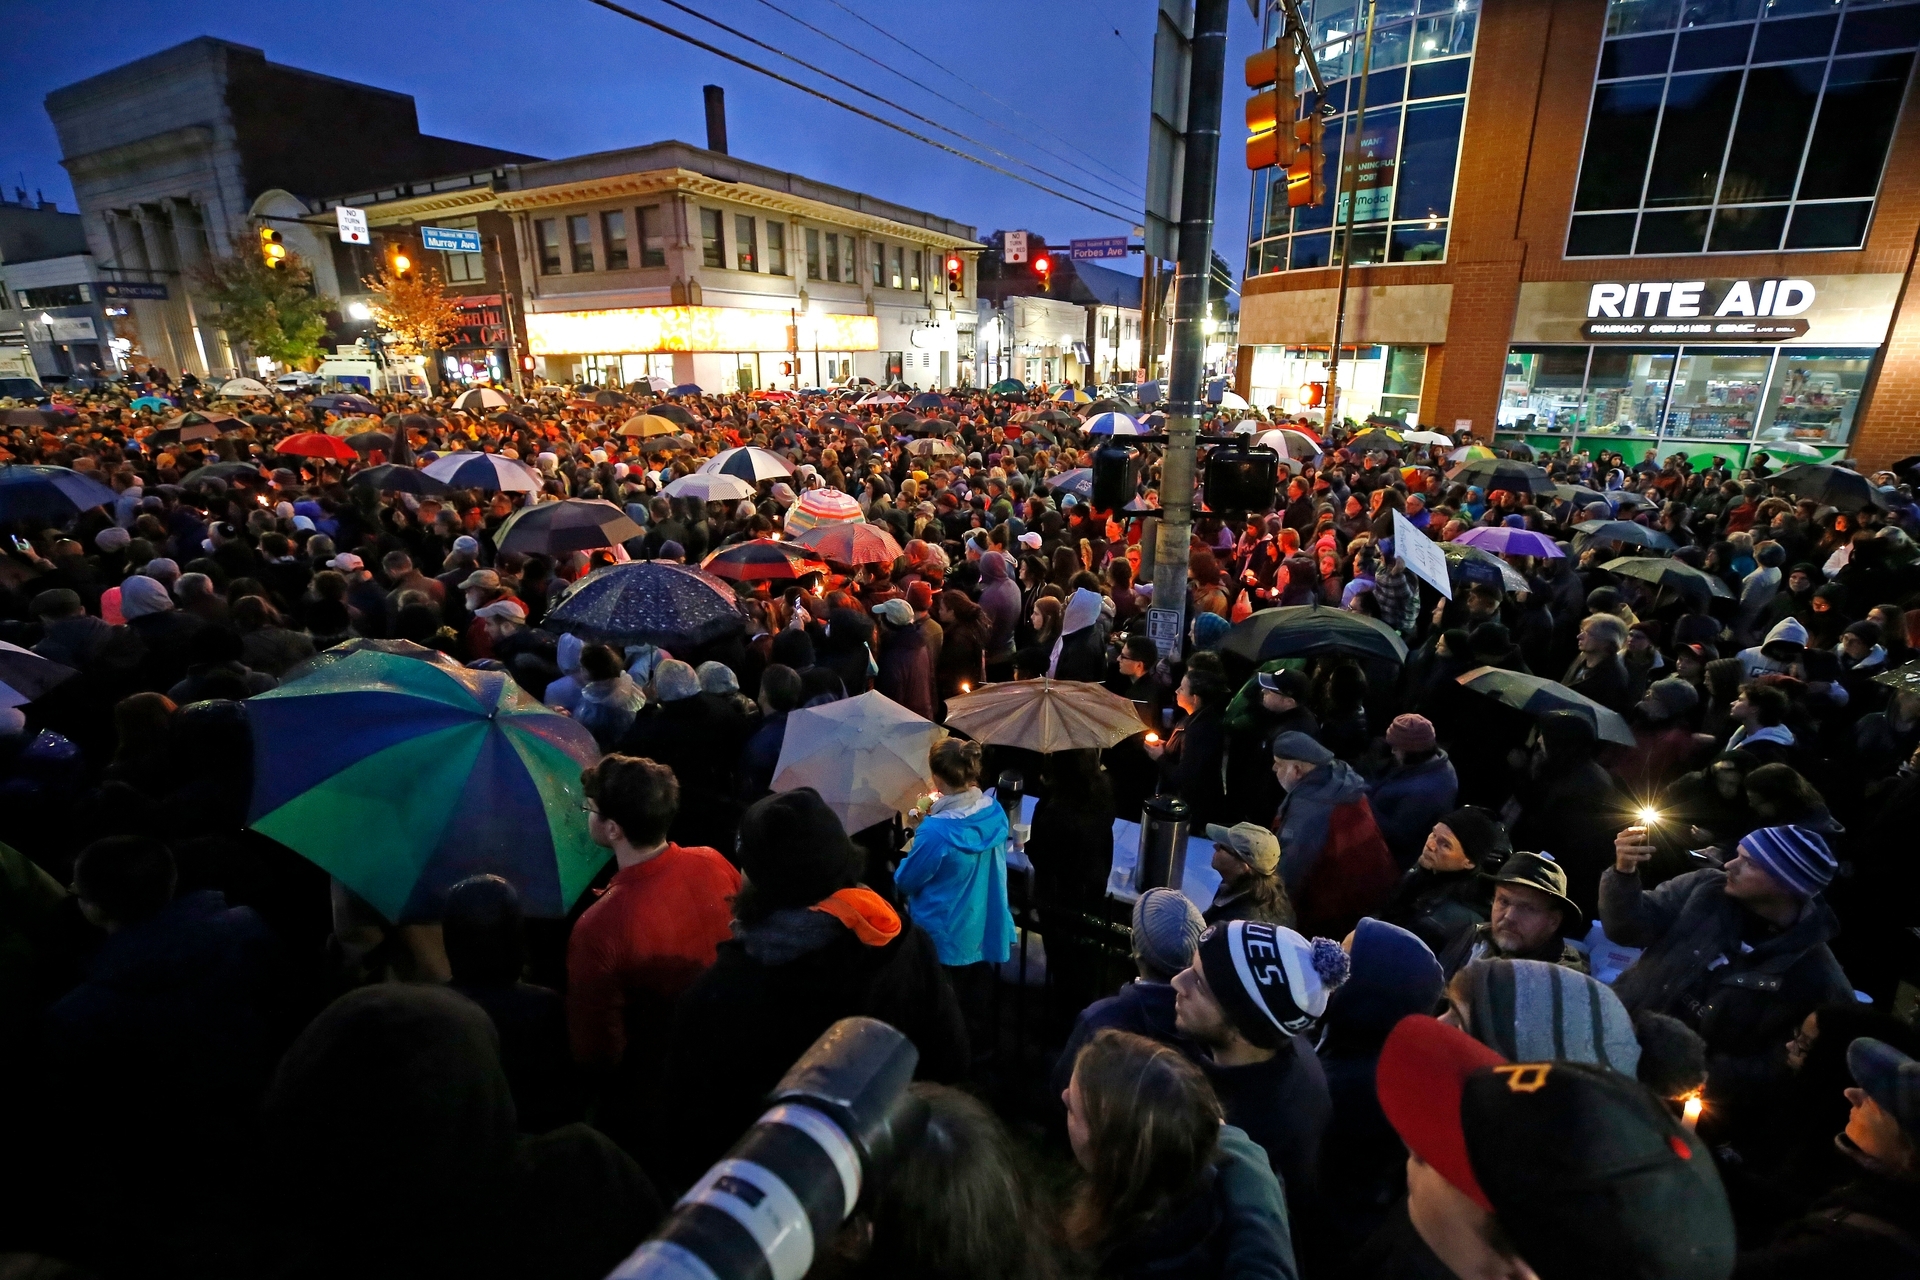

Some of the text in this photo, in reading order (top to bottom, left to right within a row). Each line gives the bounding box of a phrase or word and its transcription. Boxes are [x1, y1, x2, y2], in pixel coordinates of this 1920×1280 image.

[1361, 137, 1383, 147] WANT
[1367, 150, 1374, 158] A
[1345, 159, 1395, 172] MANINGFUL
[346, 209, 357, 217] NO
[428, 237, 476, 250] Murray Ave
[1074, 247, 1123, 258] Forbes Ave
[119, 286, 139, 295] PNC
[1587, 279, 1816, 318] RITE AID
[1590, 325, 1645, 333] PHARMACY
[1649, 324, 1677, 333] OPEN
[1676, 325, 1690, 333] 24
[1690, 324, 1711, 333] HRS
[1715, 324, 1756, 333] GNC
[1246, 923, 1285, 986] UES
[1493, 1062, 1552, 1094] P
